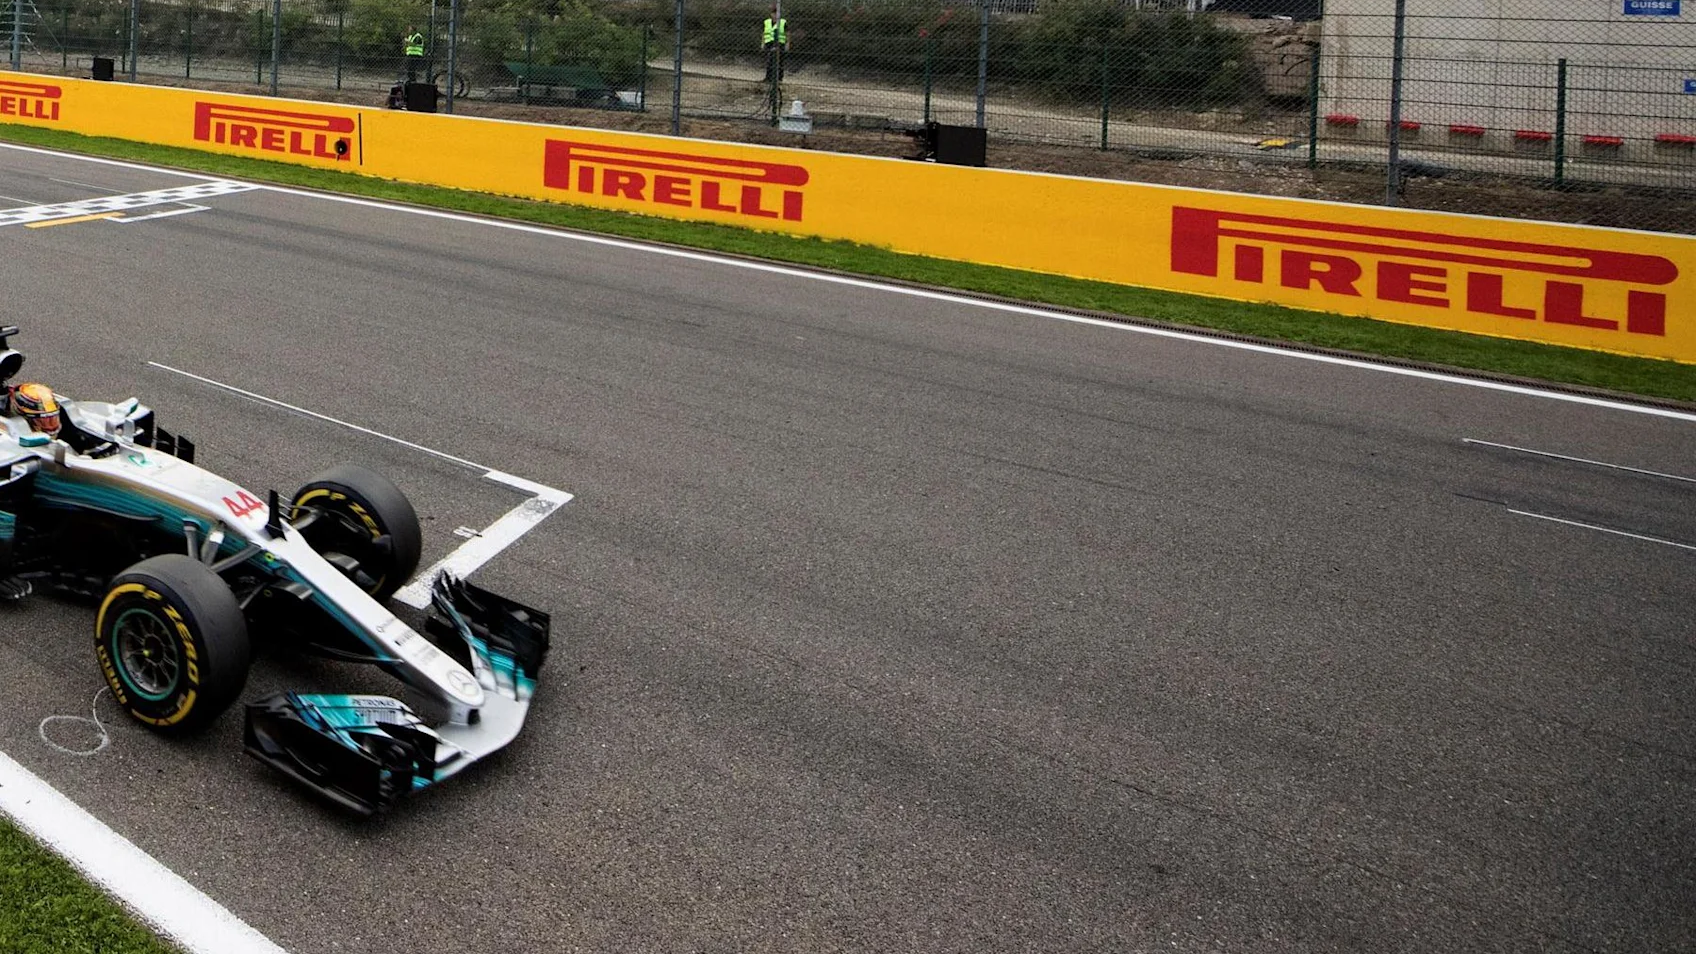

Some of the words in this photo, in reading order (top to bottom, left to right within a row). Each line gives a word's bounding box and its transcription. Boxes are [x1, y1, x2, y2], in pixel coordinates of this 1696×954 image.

[193, 101, 356, 163] PIRELLI
[542, 138, 810, 223] PIRELLI
[1170, 205, 1680, 338] PIRELLI
[222, 490, 264, 518] 44
[162, 604, 200, 686] ZERO
